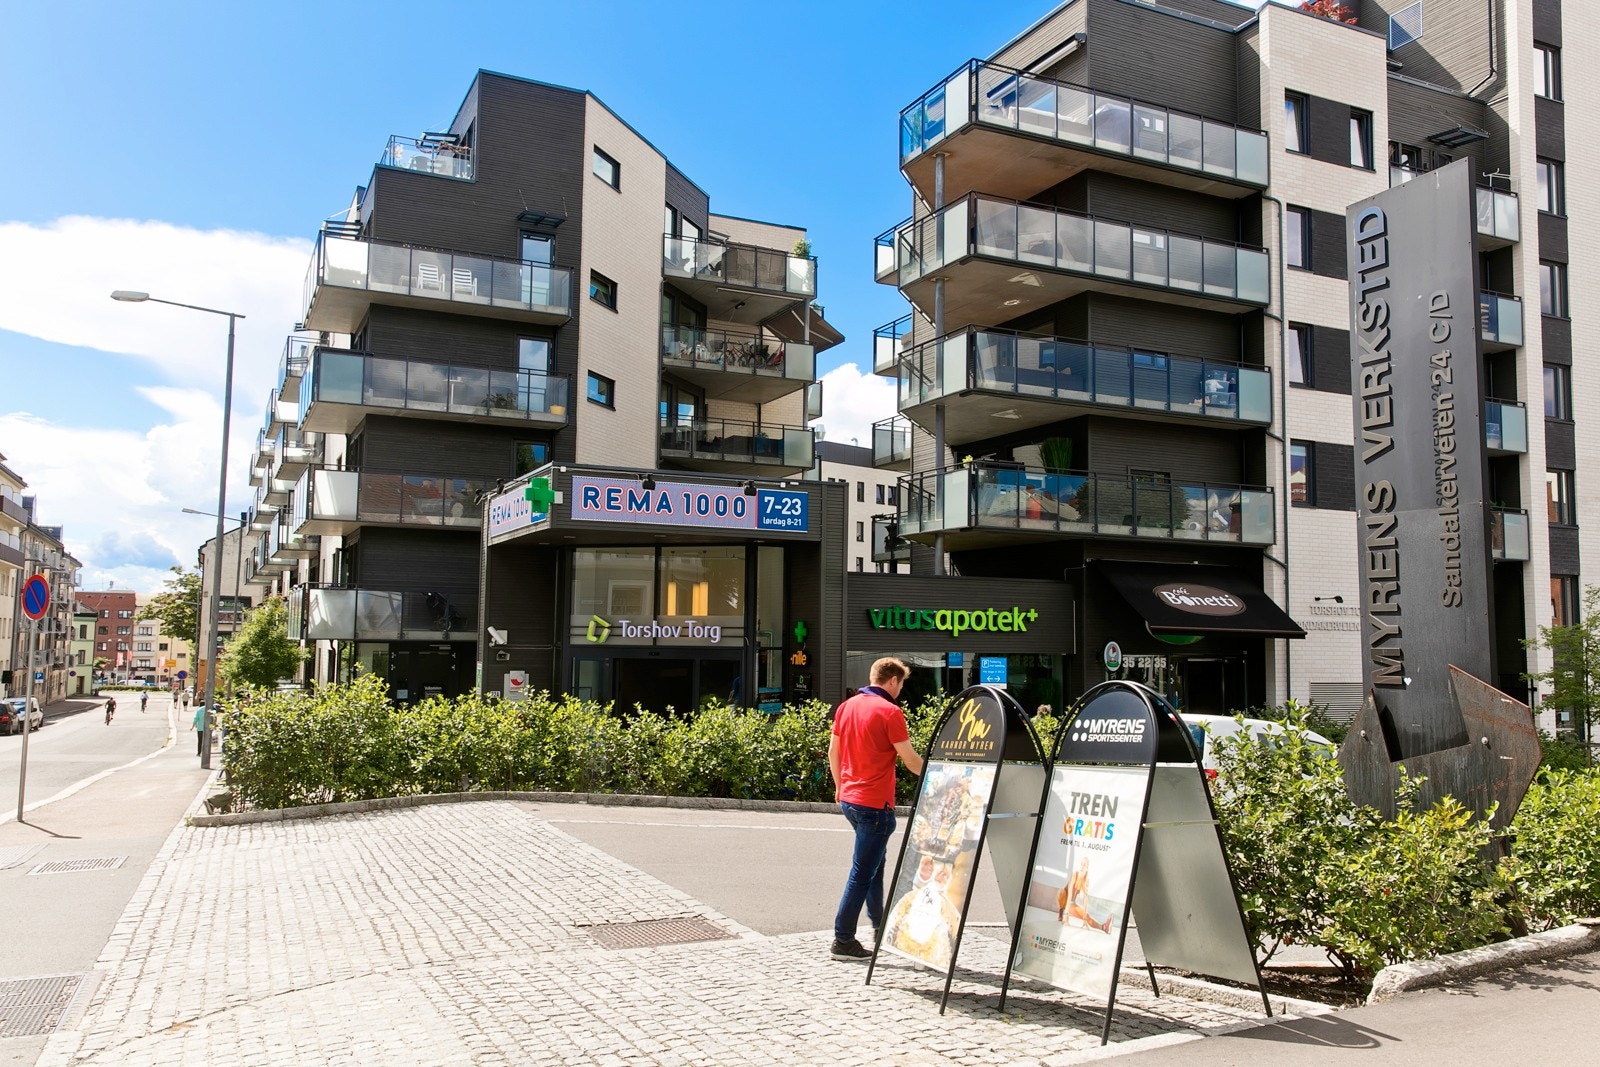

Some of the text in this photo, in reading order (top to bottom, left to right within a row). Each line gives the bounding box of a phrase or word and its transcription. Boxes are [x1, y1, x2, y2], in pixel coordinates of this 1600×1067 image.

[1355, 206, 1404, 688] MYRENS VERKSTED
[1428, 289, 1461, 608] Sandakerveien 24 C/D
[582, 485, 748, 519] REMA 1000
[764, 496, 803, 516] 7-23
[492, 502, 511, 526] REMA
[763, 516, 803, 527] lørdag 8-21
[619, 620, 722, 643] Torshov Torg
[1122, 656, 1167, 669] 35 22 35
[1089, 719, 1146, 734] MYRENS
[1087, 734, 1143, 743] SPORTSSENTER
[1070, 791, 1119, 819] TREN
[1063, 817, 1115, 841] GRATIS
[1039, 936, 1066, 952] MYRENS
